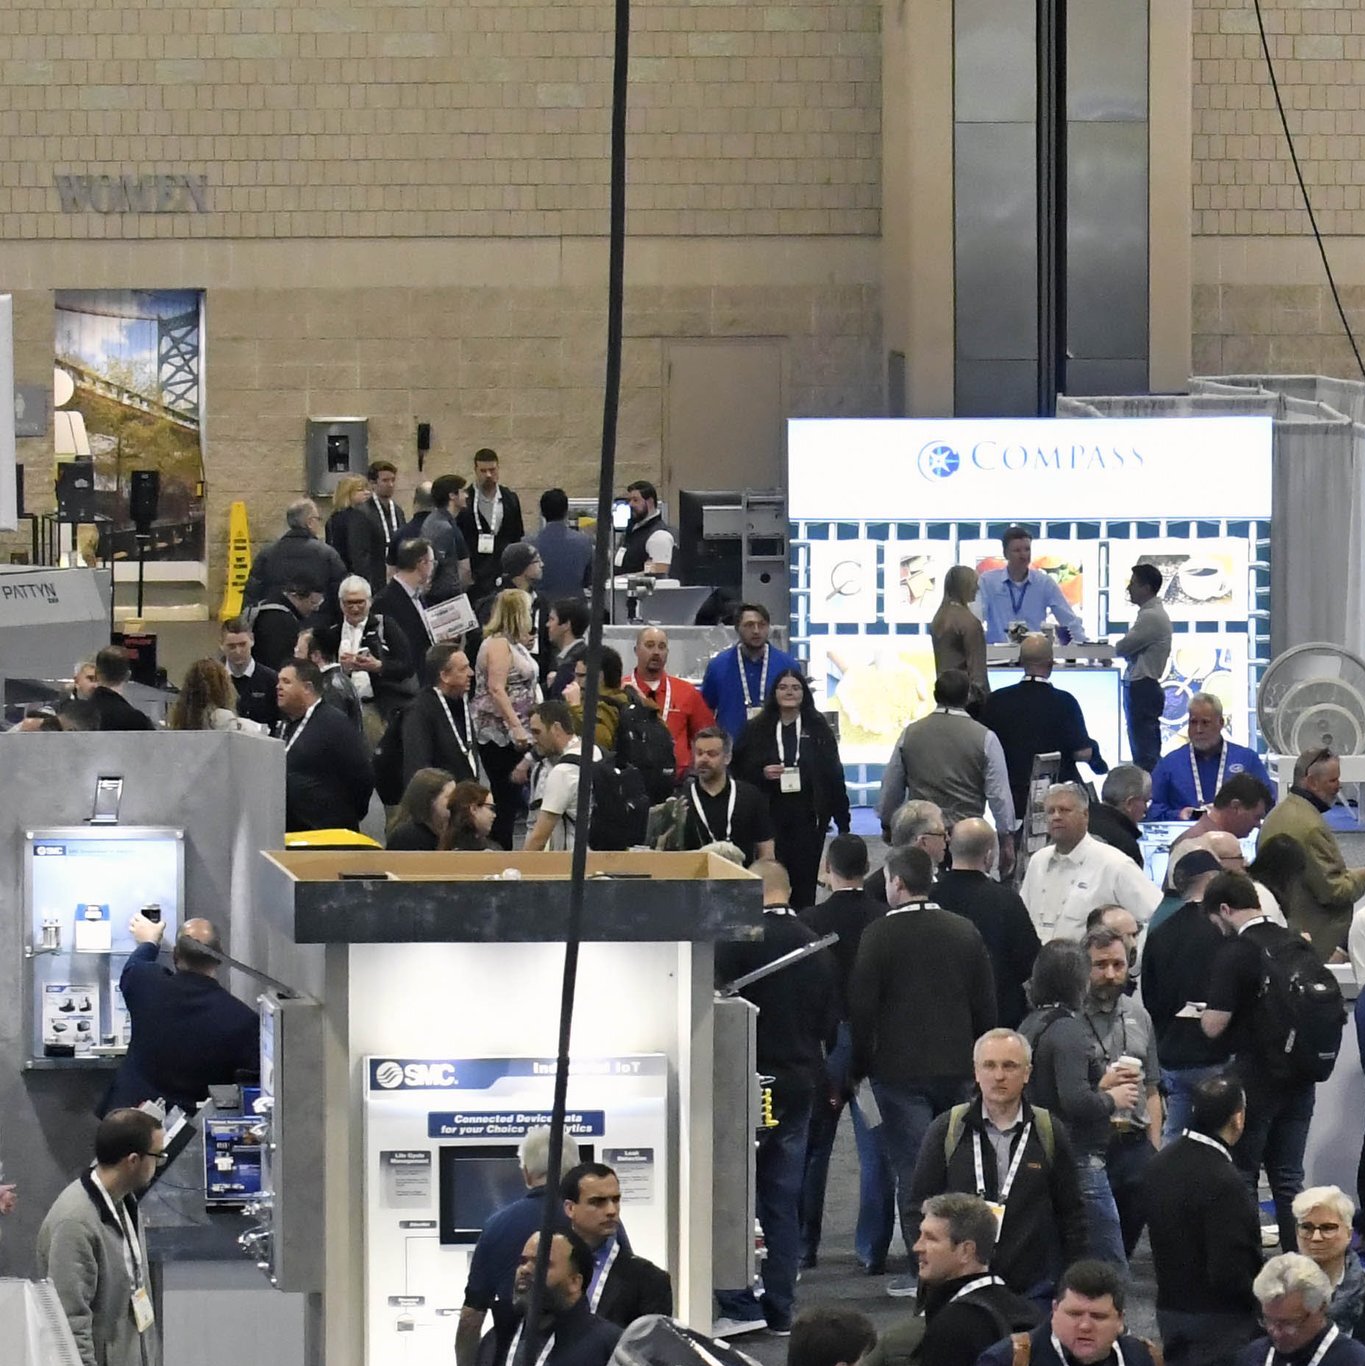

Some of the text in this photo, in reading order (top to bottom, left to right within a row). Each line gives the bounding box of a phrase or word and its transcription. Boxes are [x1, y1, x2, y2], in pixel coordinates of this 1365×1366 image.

[53, 173, 208, 214] WOMEN
[2, 583, 58, 600] PATTYN
[615, 1060, 641, 1074] IoT
[453, 1114, 515, 1124] Connected
[559, 1113, 583, 1123] ata
[440, 1125, 457, 1134] for
[459, 1125, 484, 1136] your
[485, 1124, 525, 1134] Choice
